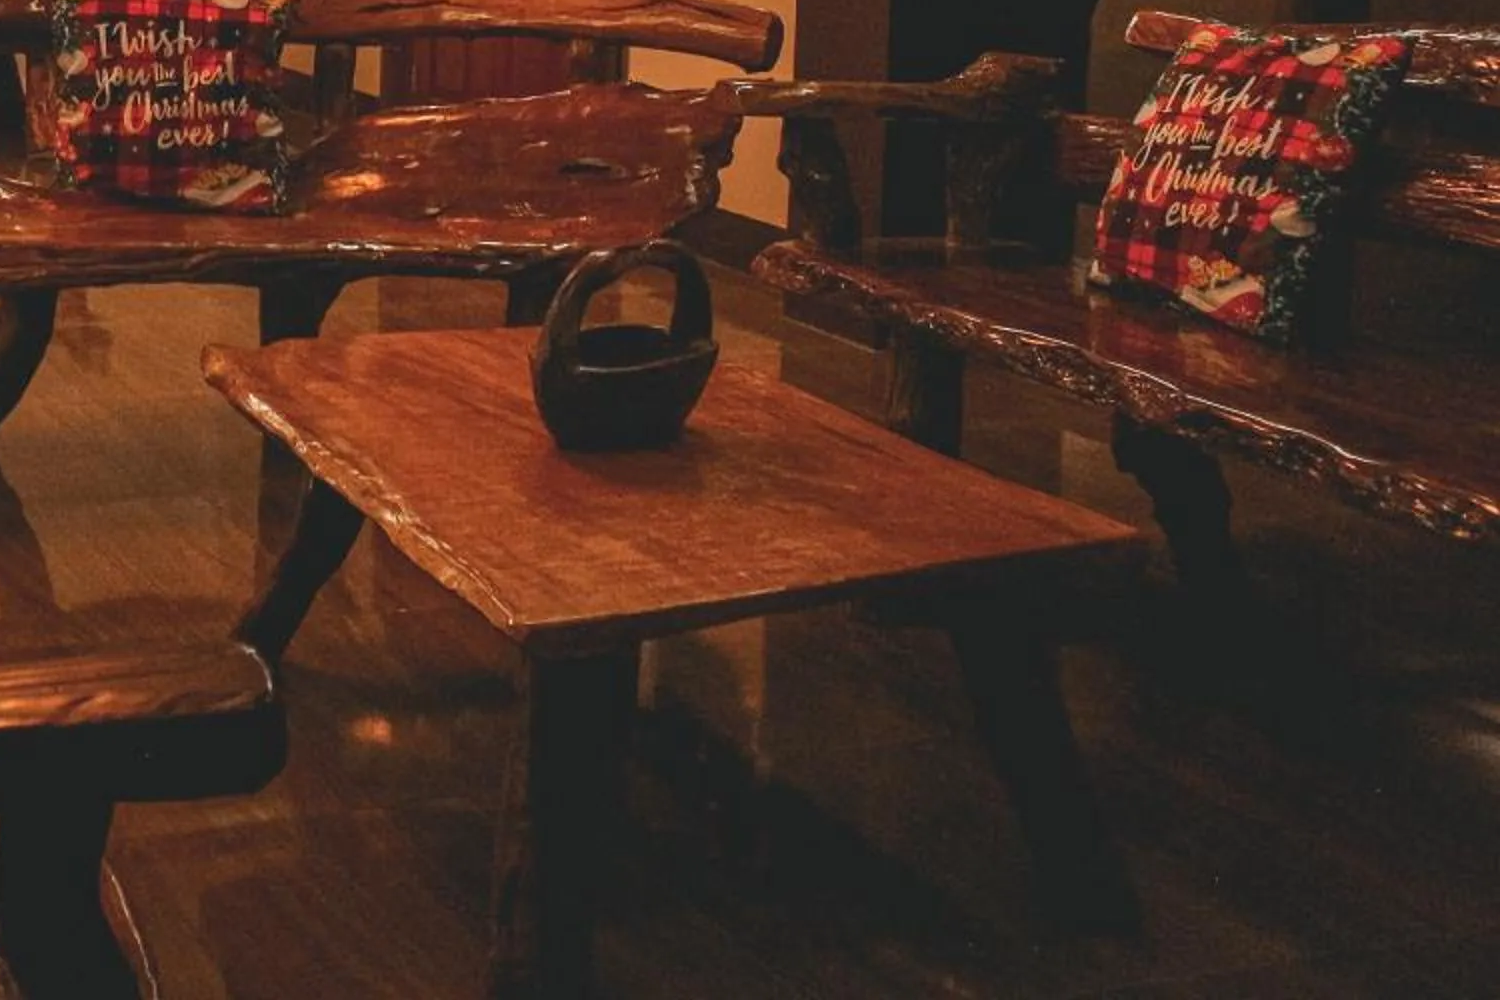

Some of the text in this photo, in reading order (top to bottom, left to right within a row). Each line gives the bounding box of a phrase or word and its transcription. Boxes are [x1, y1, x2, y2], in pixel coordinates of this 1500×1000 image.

[92, 65, 150, 111] you
[183, 51, 235, 93] best
[122, 91, 250, 133] Christmas
[1132, 120, 1189, 171] you
[1213, 115, 1283, 160] best
[1145, 151, 1280, 204] Christmas
